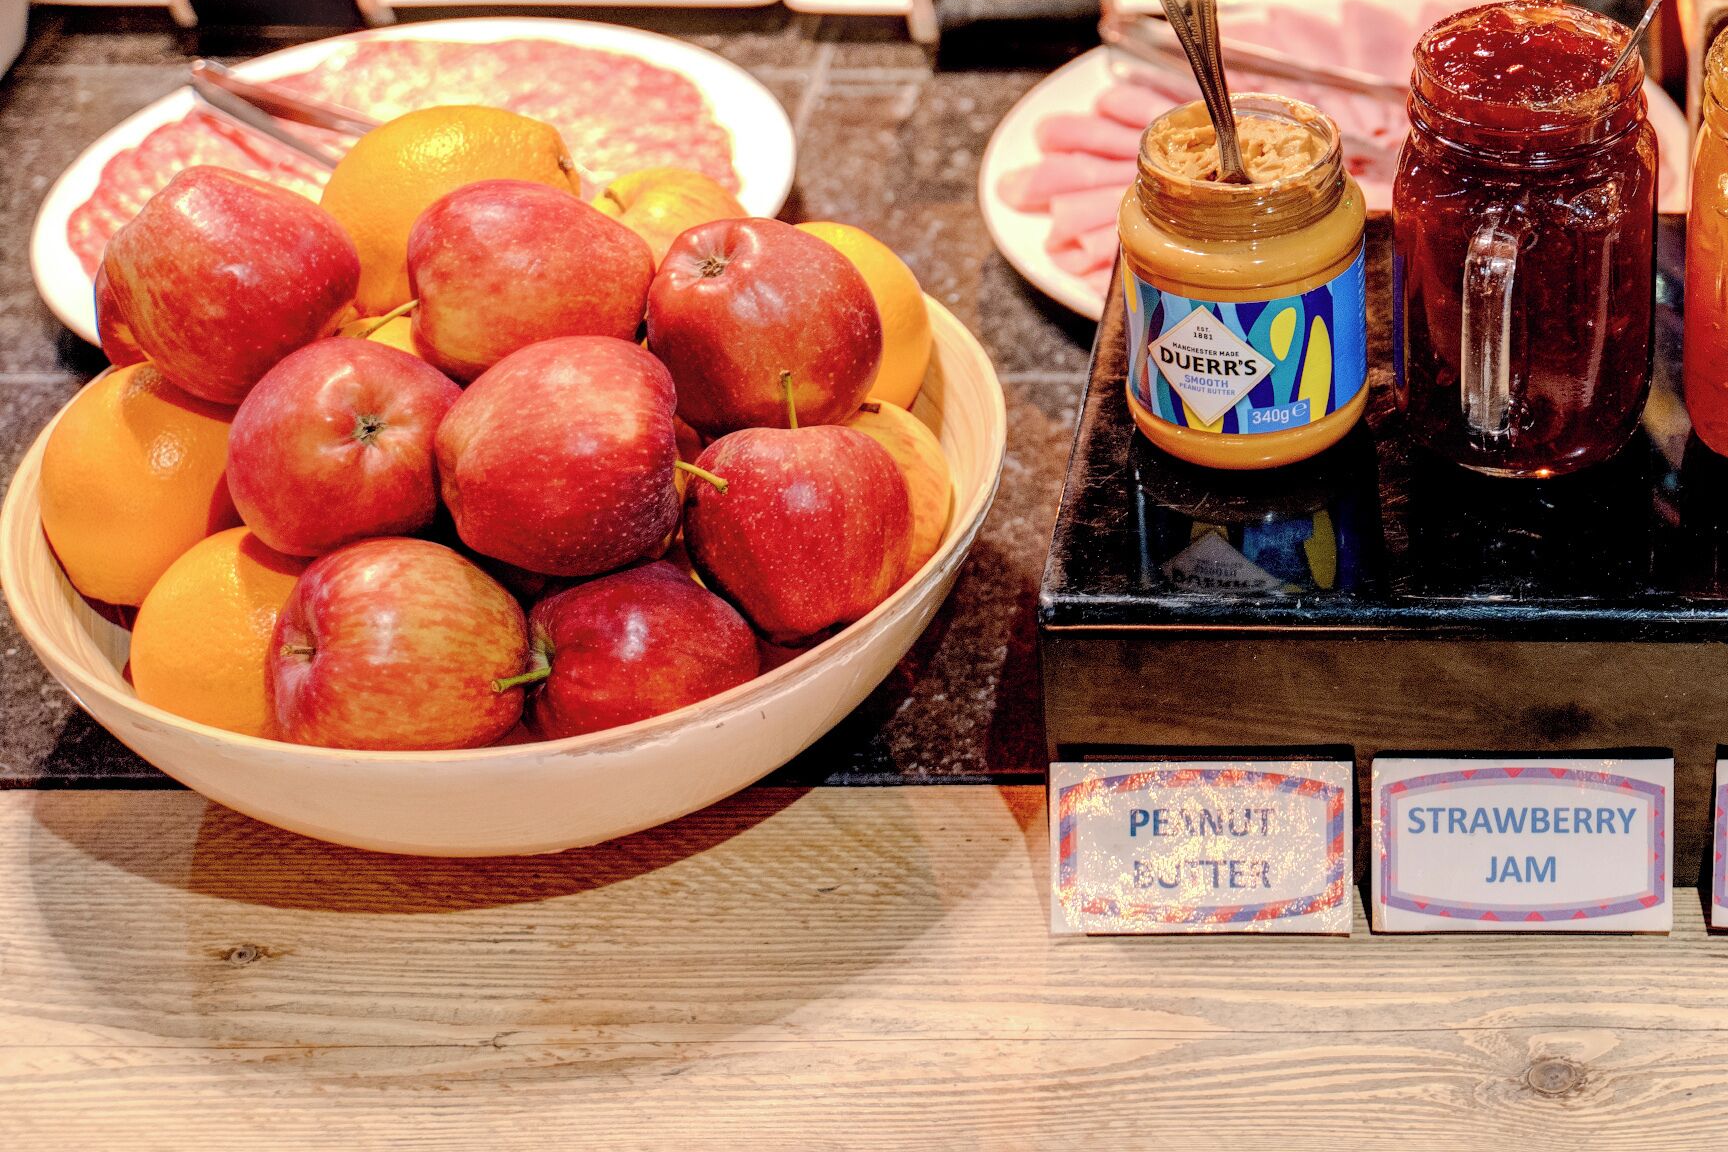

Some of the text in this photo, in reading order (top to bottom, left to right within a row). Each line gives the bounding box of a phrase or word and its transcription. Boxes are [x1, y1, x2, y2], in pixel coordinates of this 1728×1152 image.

[1193, 331, 1213, 340] 1881
[1172, 341, 1218, 356] MANCHESTER
[1160, 344, 1257, 376] DUERR'S
[1179, 382, 1236, 396] PEANUT BUTTER
[1184, 374, 1229, 388] SMOOTH
[1252, 408, 1290, 424] 340g
[1129, 808, 1274, 837] PEANUT
[1407, 806, 1638, 835] STRAWBERRY
[1485, 855, 1558, 884] JAM
